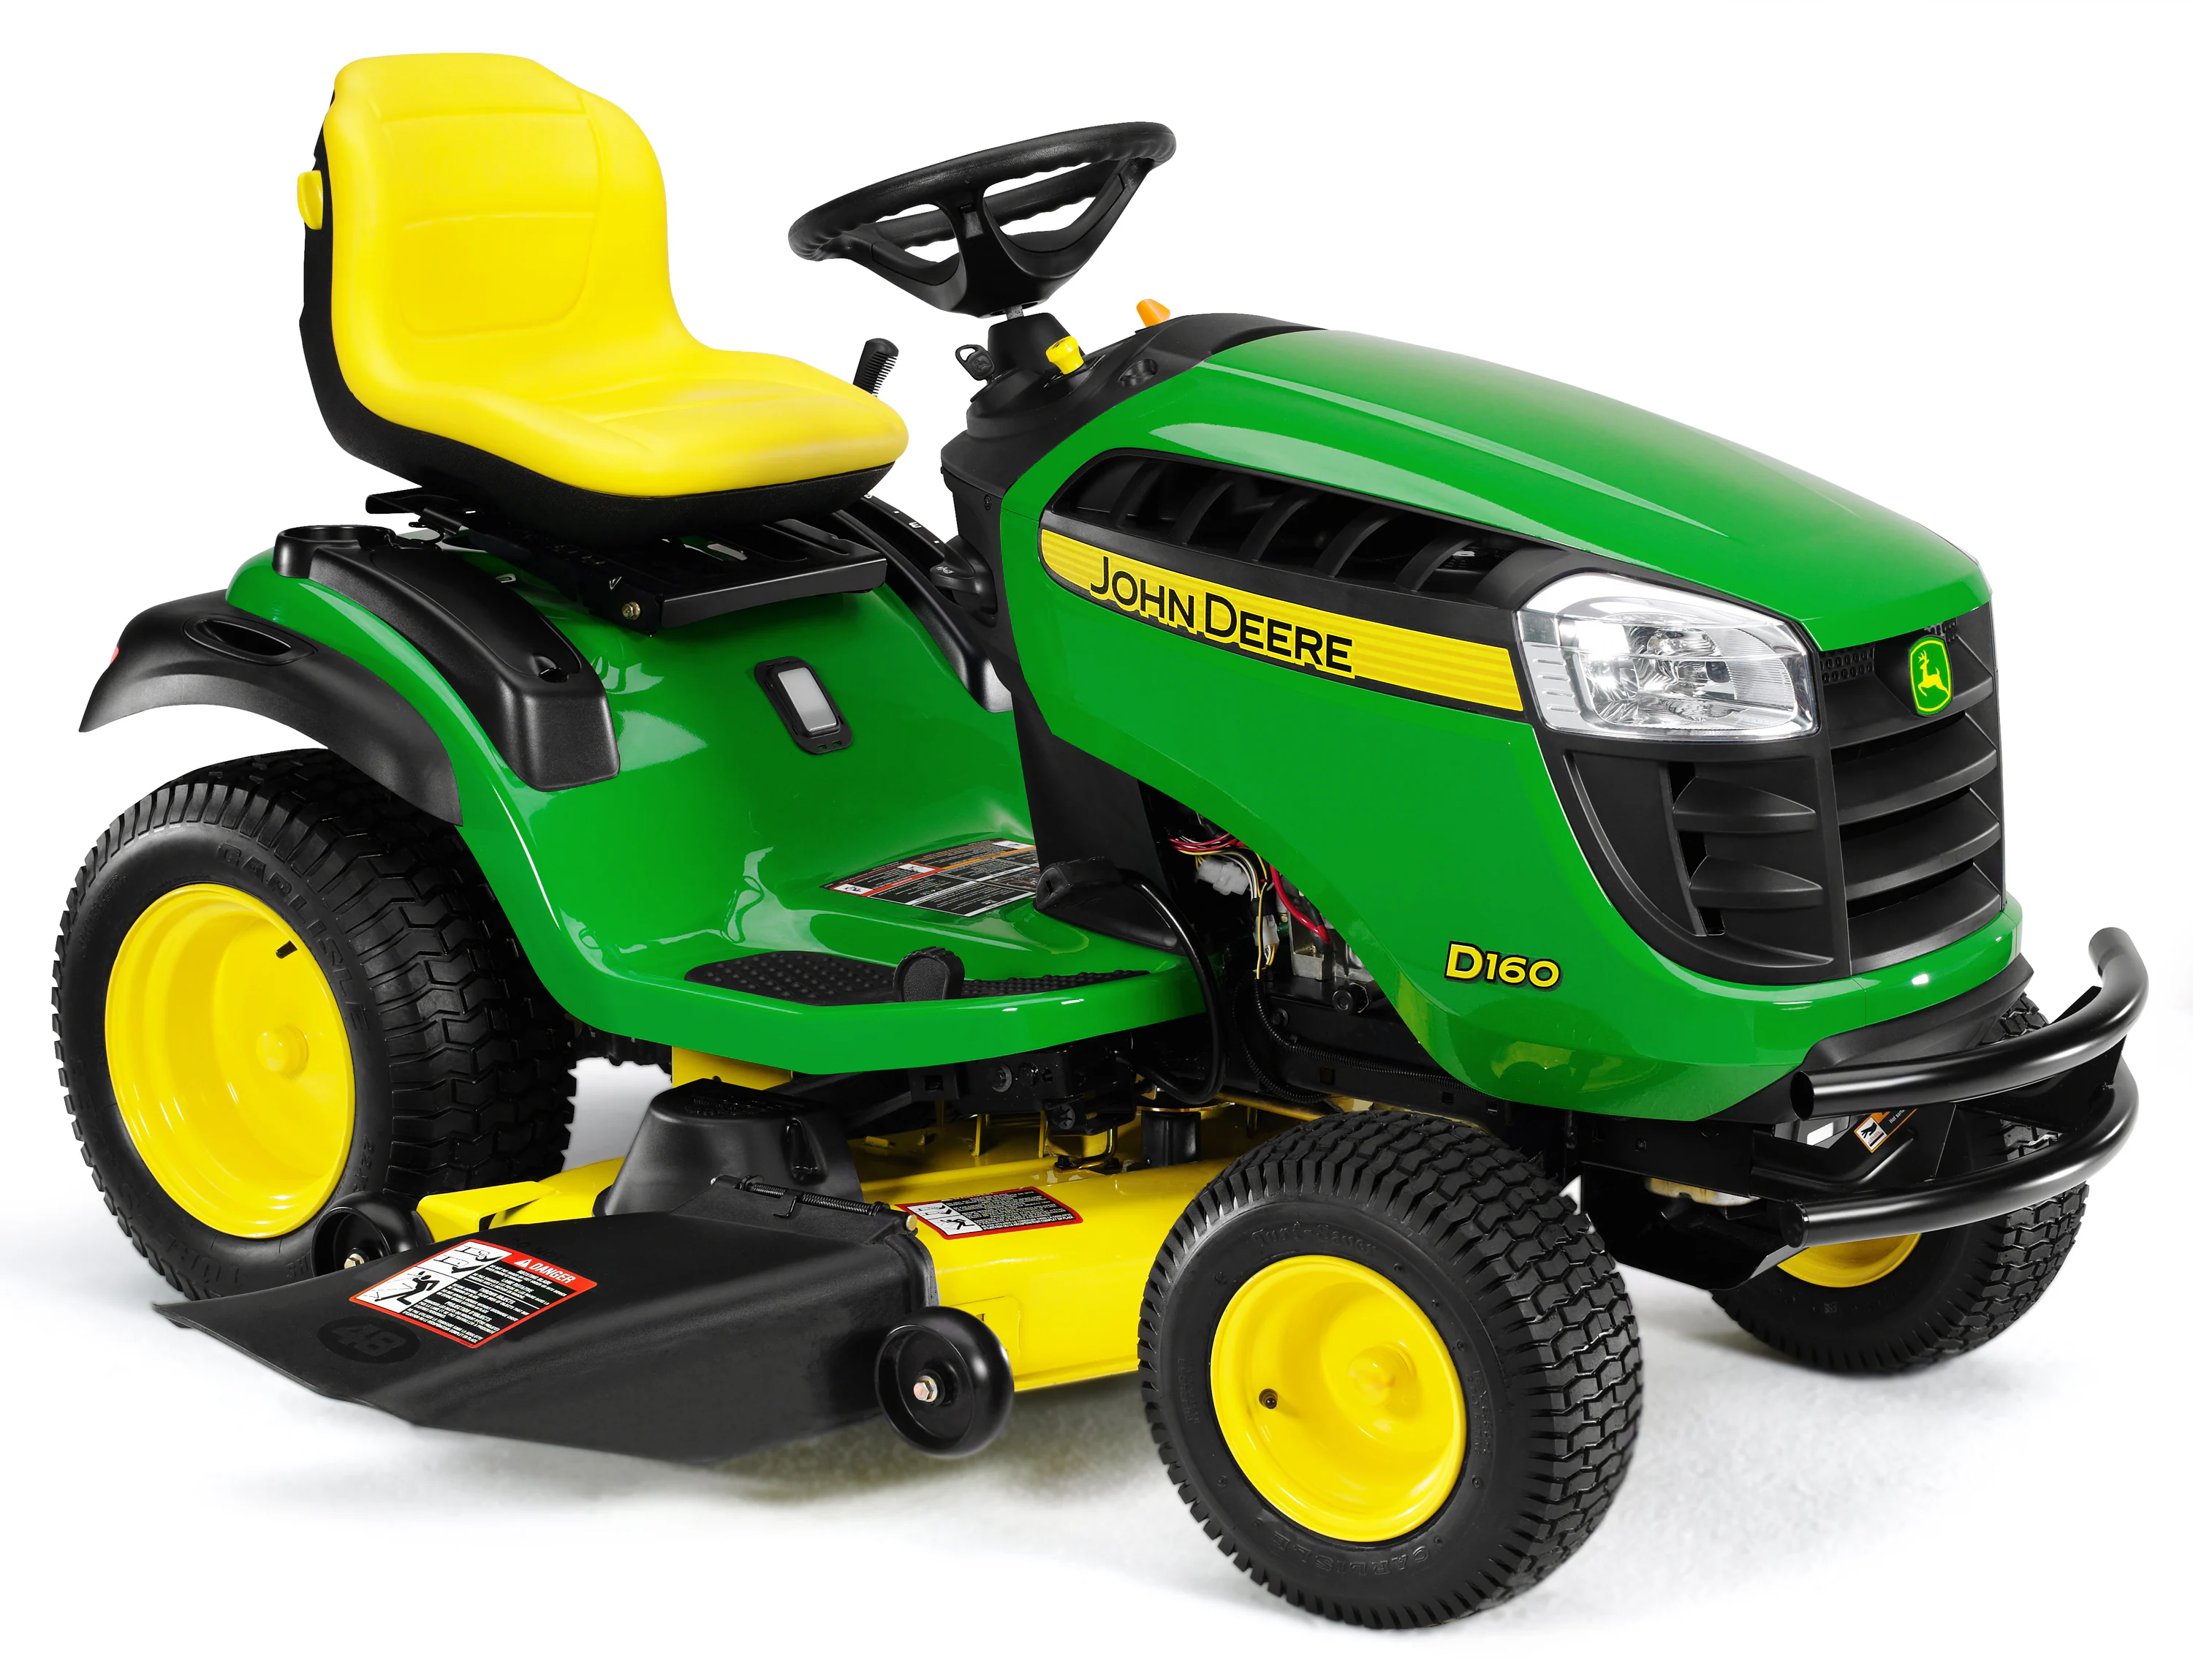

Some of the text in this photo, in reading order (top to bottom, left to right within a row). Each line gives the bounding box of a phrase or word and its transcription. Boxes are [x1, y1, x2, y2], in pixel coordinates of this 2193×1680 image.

[1090, 556, 1353, 673] JOHN DEERE
[1444, 941, 1561, 988] D160
[529, 1263, 576, 1284] DANGER
[331, 1324, 408, 1357] 48
